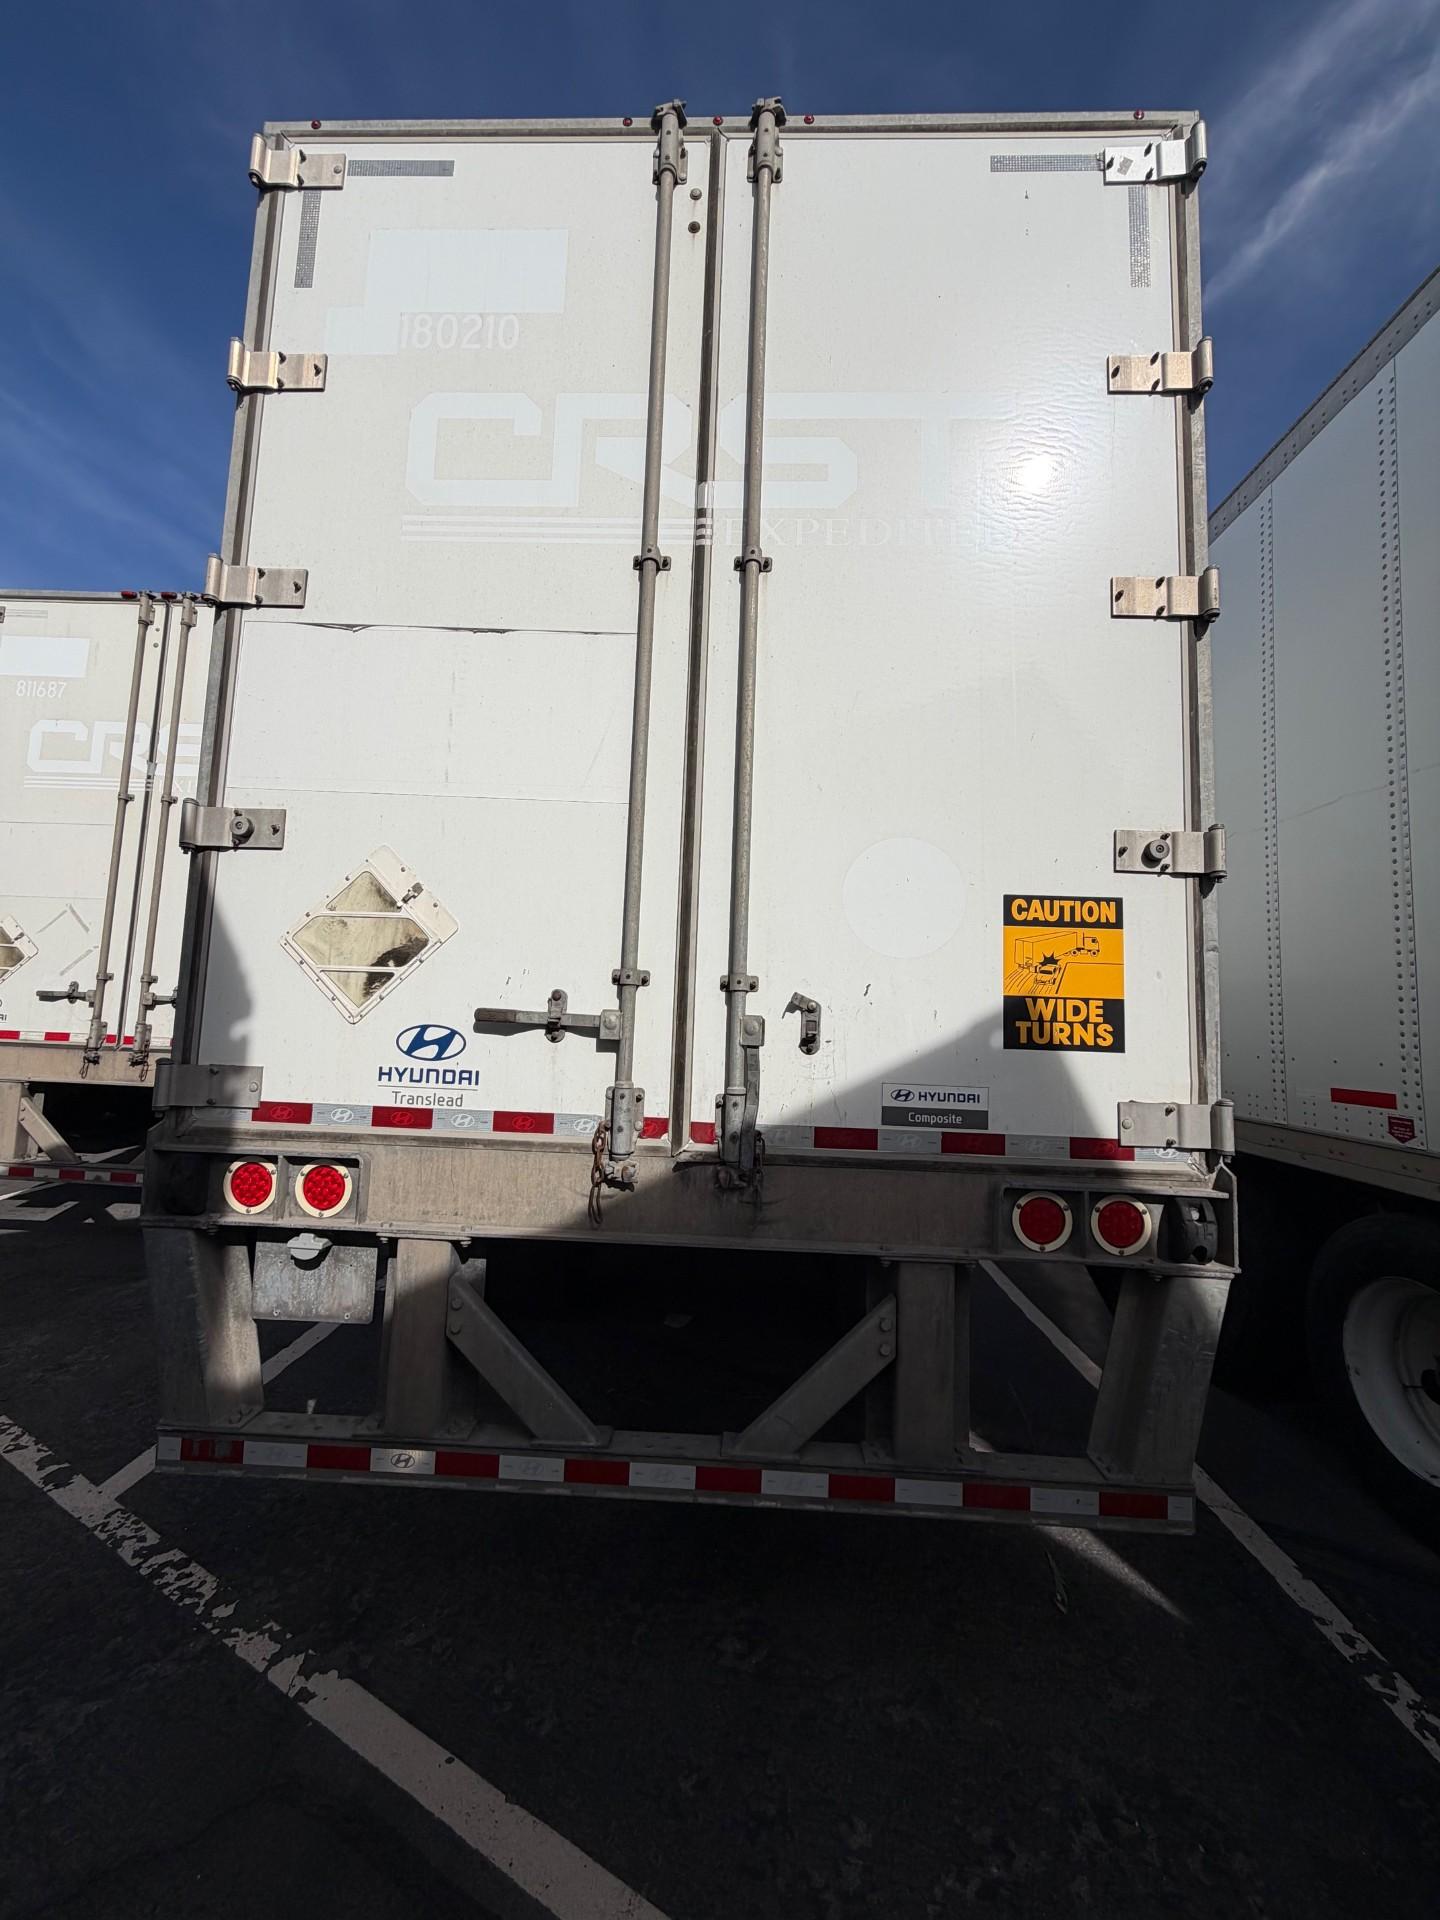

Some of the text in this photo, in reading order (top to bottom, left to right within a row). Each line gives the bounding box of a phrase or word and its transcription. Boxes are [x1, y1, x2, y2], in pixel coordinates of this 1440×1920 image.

[401, 313, 520, 350] 180210
[16, 680, 67, 699] 811687
[1011, 898, 1116, 923] CAUTION
[1025, 998, 1104, 1023] WIDE
[1016, 1021, 1114, 1047] TURNS
[378, 1066, 480, 1086] HYUNDAI
[391, 1091, 464, 1108] Translead
[918, 1091, 980, 1104] HYUNDAI
[908, 1112, 963, 1125] Composite
